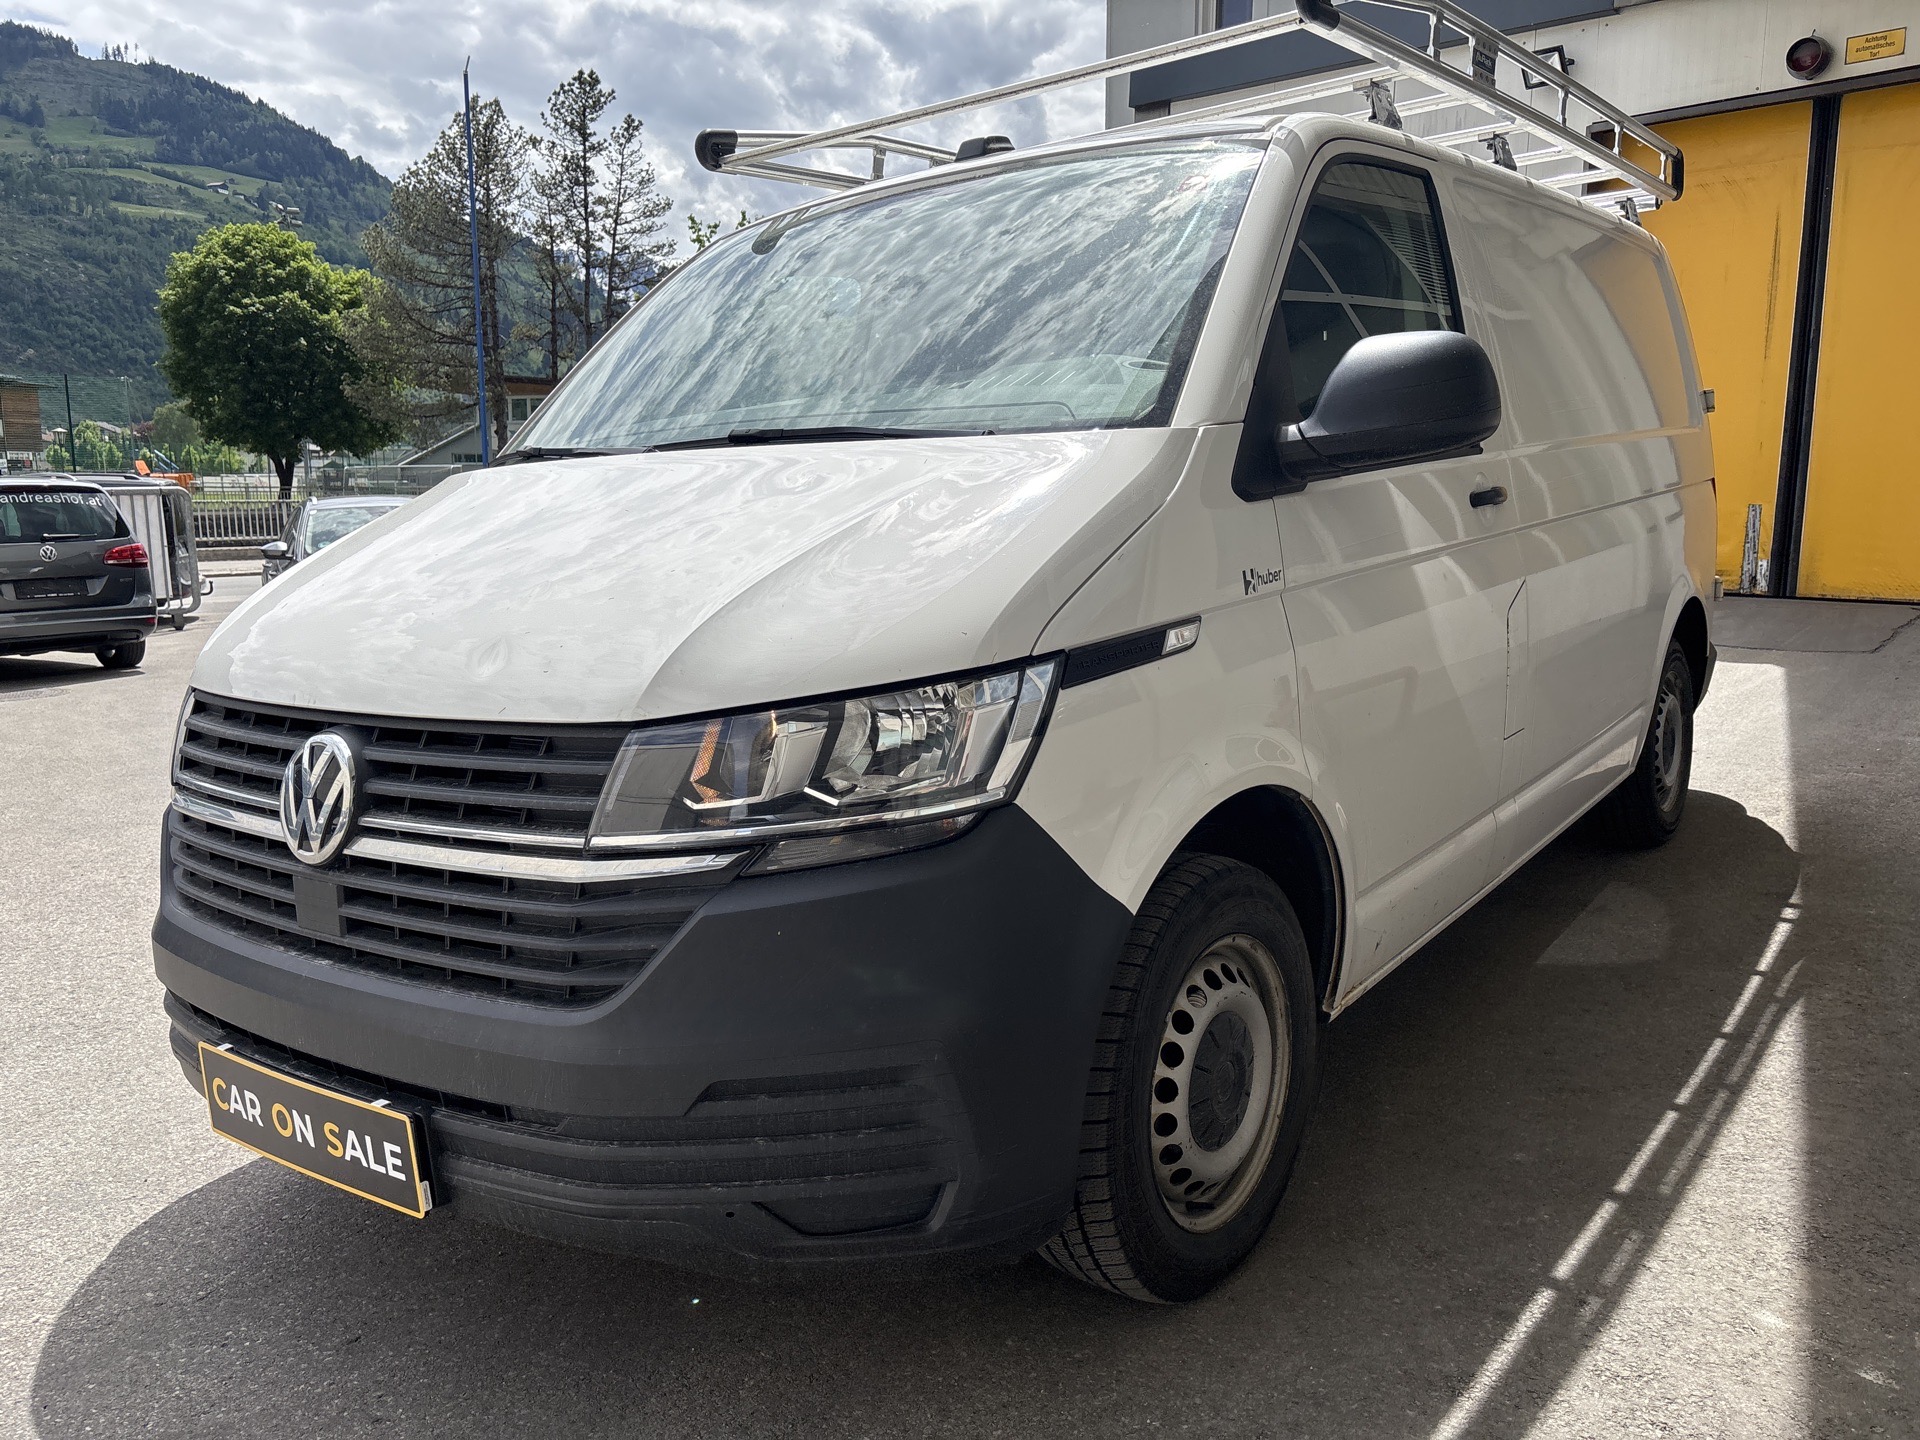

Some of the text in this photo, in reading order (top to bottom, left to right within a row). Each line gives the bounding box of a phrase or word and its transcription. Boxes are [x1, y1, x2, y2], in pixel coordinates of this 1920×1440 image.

[1855, 41, 1896, 53] automatisches
[1864, 35, 1888, 44] Achtung
[0, 491, 103, 507] andreashof.at
[39, 545, 58, 562] VW
[1257, 568, 1282, 586] huber
[1076, 640, 1160, 670] TRANSPORTER
[280, 734, 355, 865] VW
[212, 1077, 406, 1182] CAR ON SALE
